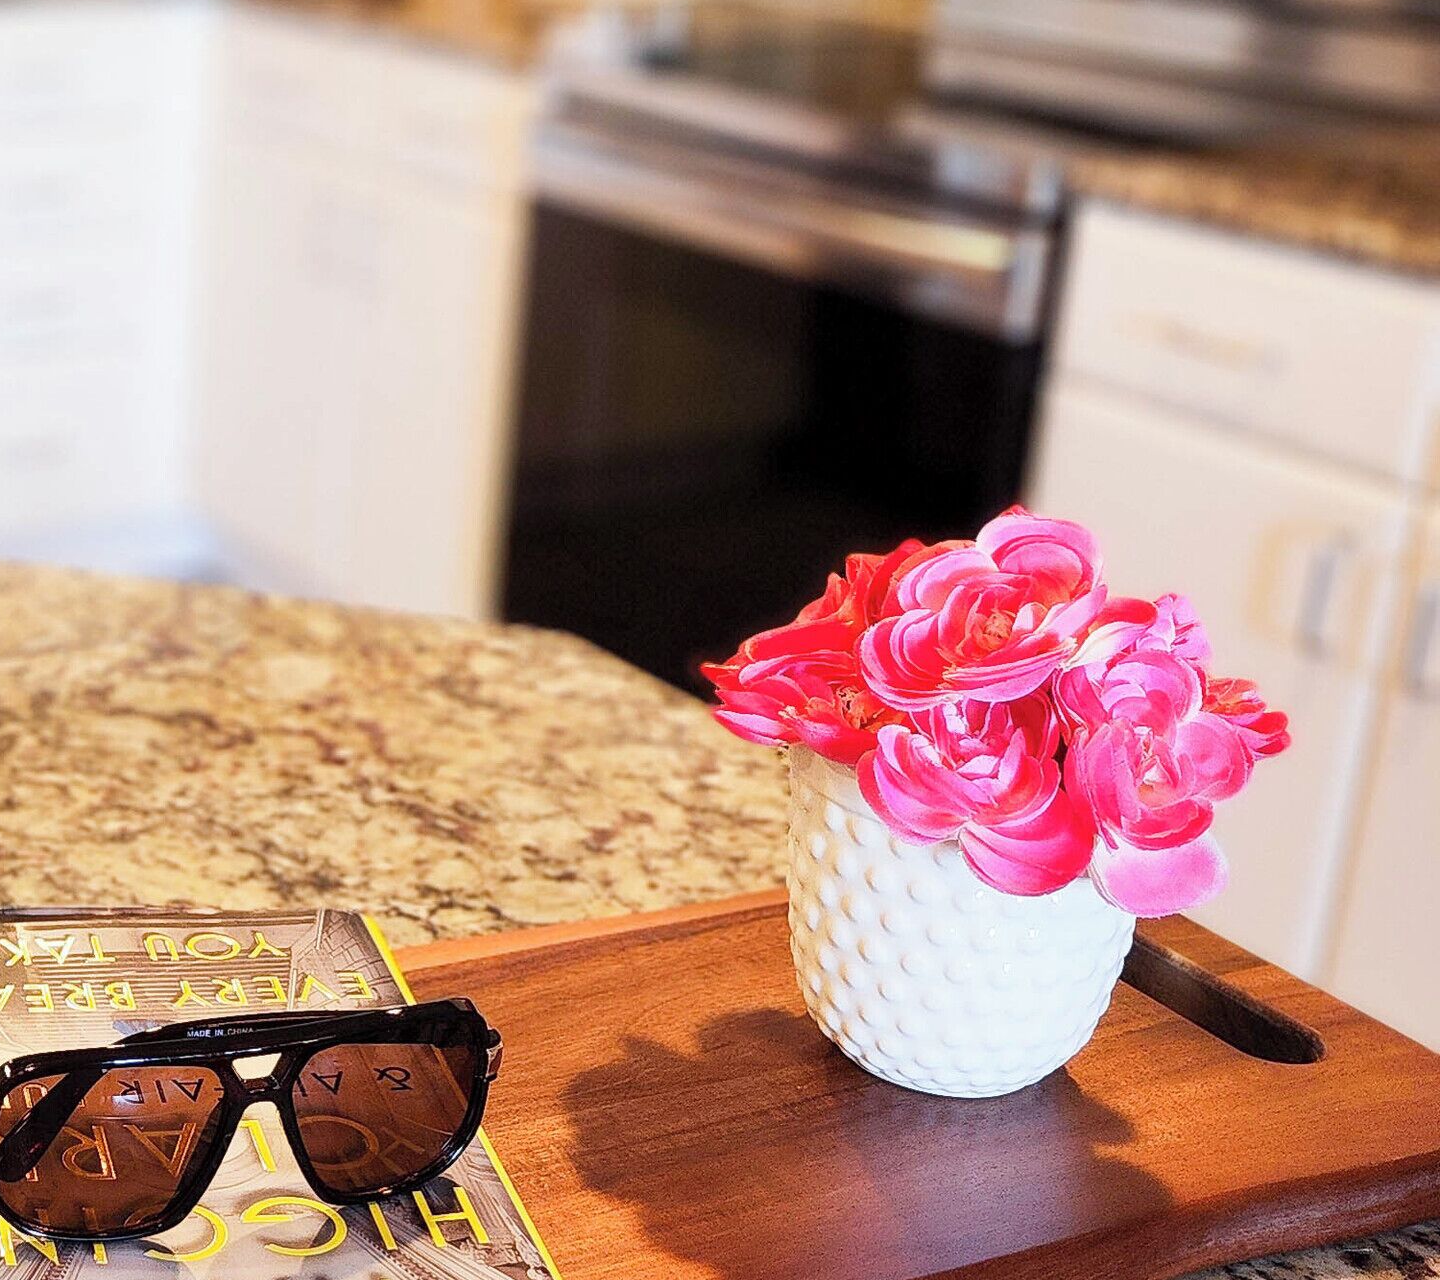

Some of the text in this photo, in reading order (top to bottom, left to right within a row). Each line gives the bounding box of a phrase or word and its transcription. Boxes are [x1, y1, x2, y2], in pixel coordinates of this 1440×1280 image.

[144, 931, 291, 961] YOU
[175, 970, 375, 1009] EVERY
[187, 1026, 255, 1039] MADE IN CHINA
[373, 1065, 414, 1092] &
